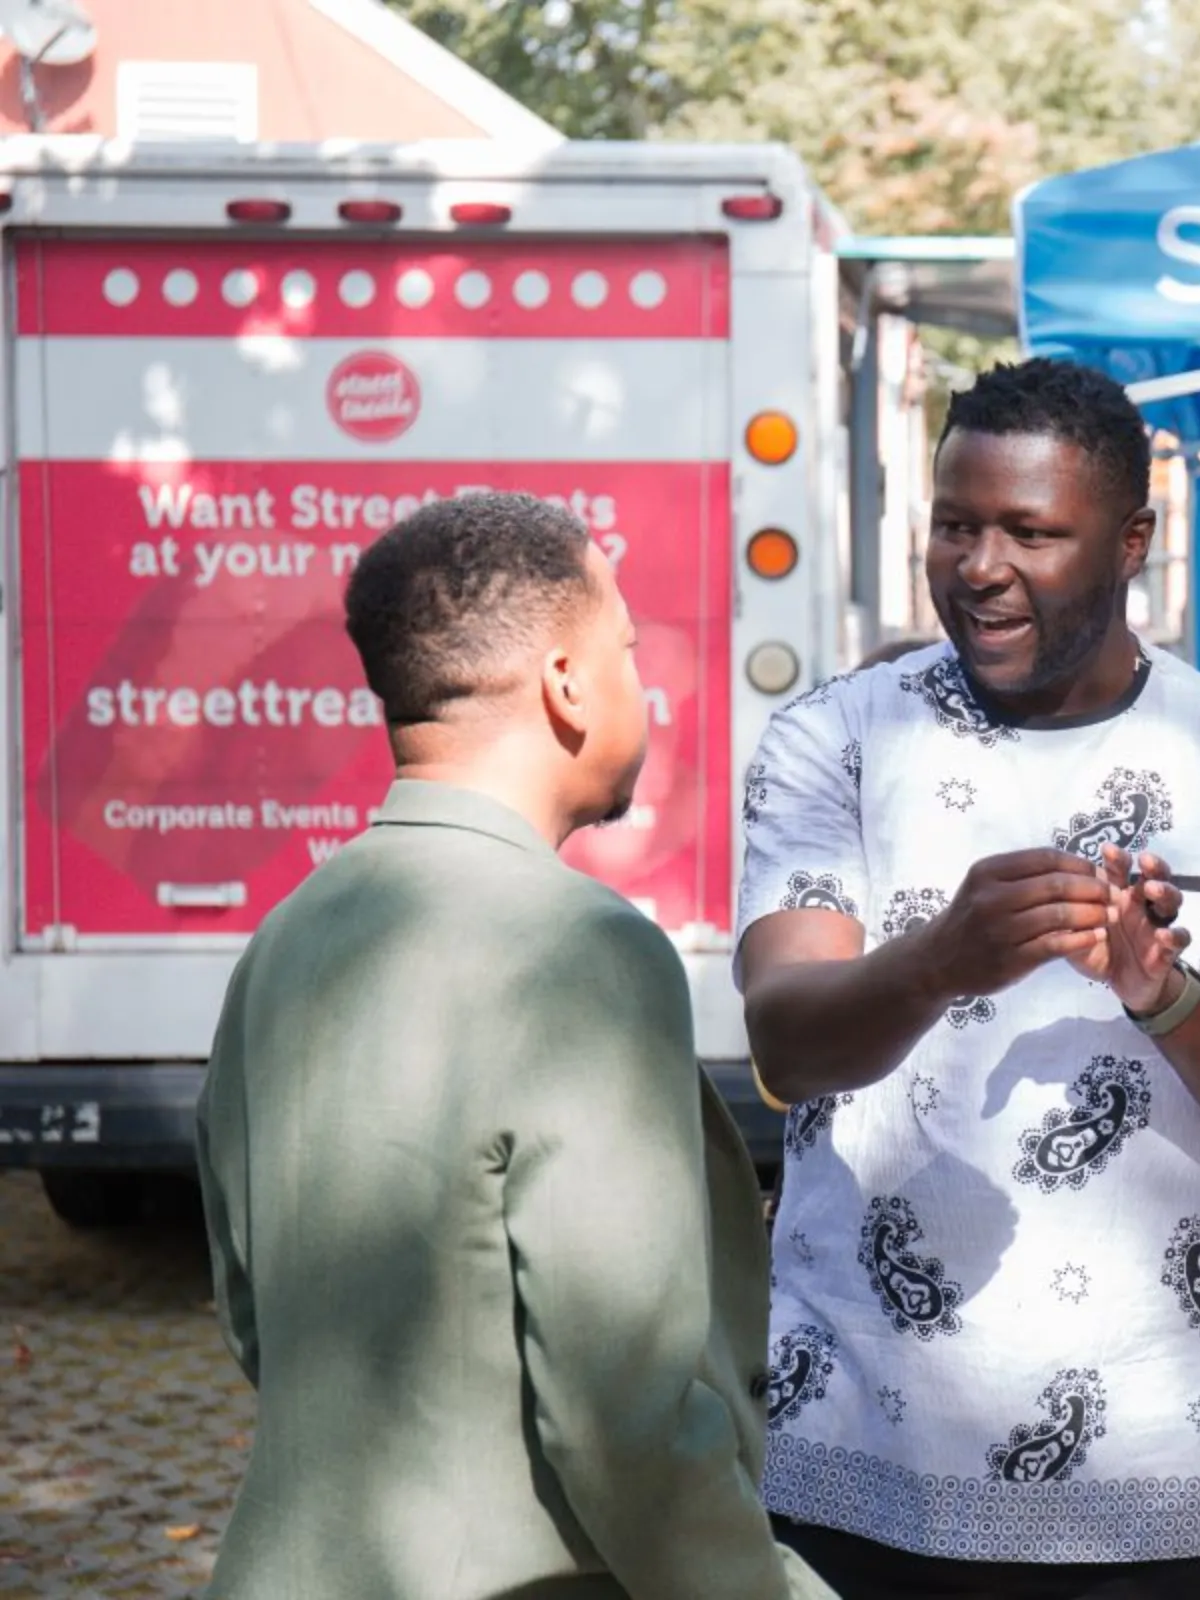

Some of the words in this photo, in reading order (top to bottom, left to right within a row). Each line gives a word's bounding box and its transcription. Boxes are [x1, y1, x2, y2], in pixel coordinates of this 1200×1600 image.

[138, 484, 276, 529] Want
[129, 536, 180, 577] at
[195, 540, 316, 588] your
[86, 679, 385, 726] streettrea
[103, 799, 253, 835] Corporate
[261, 800, 358, 830] Events
